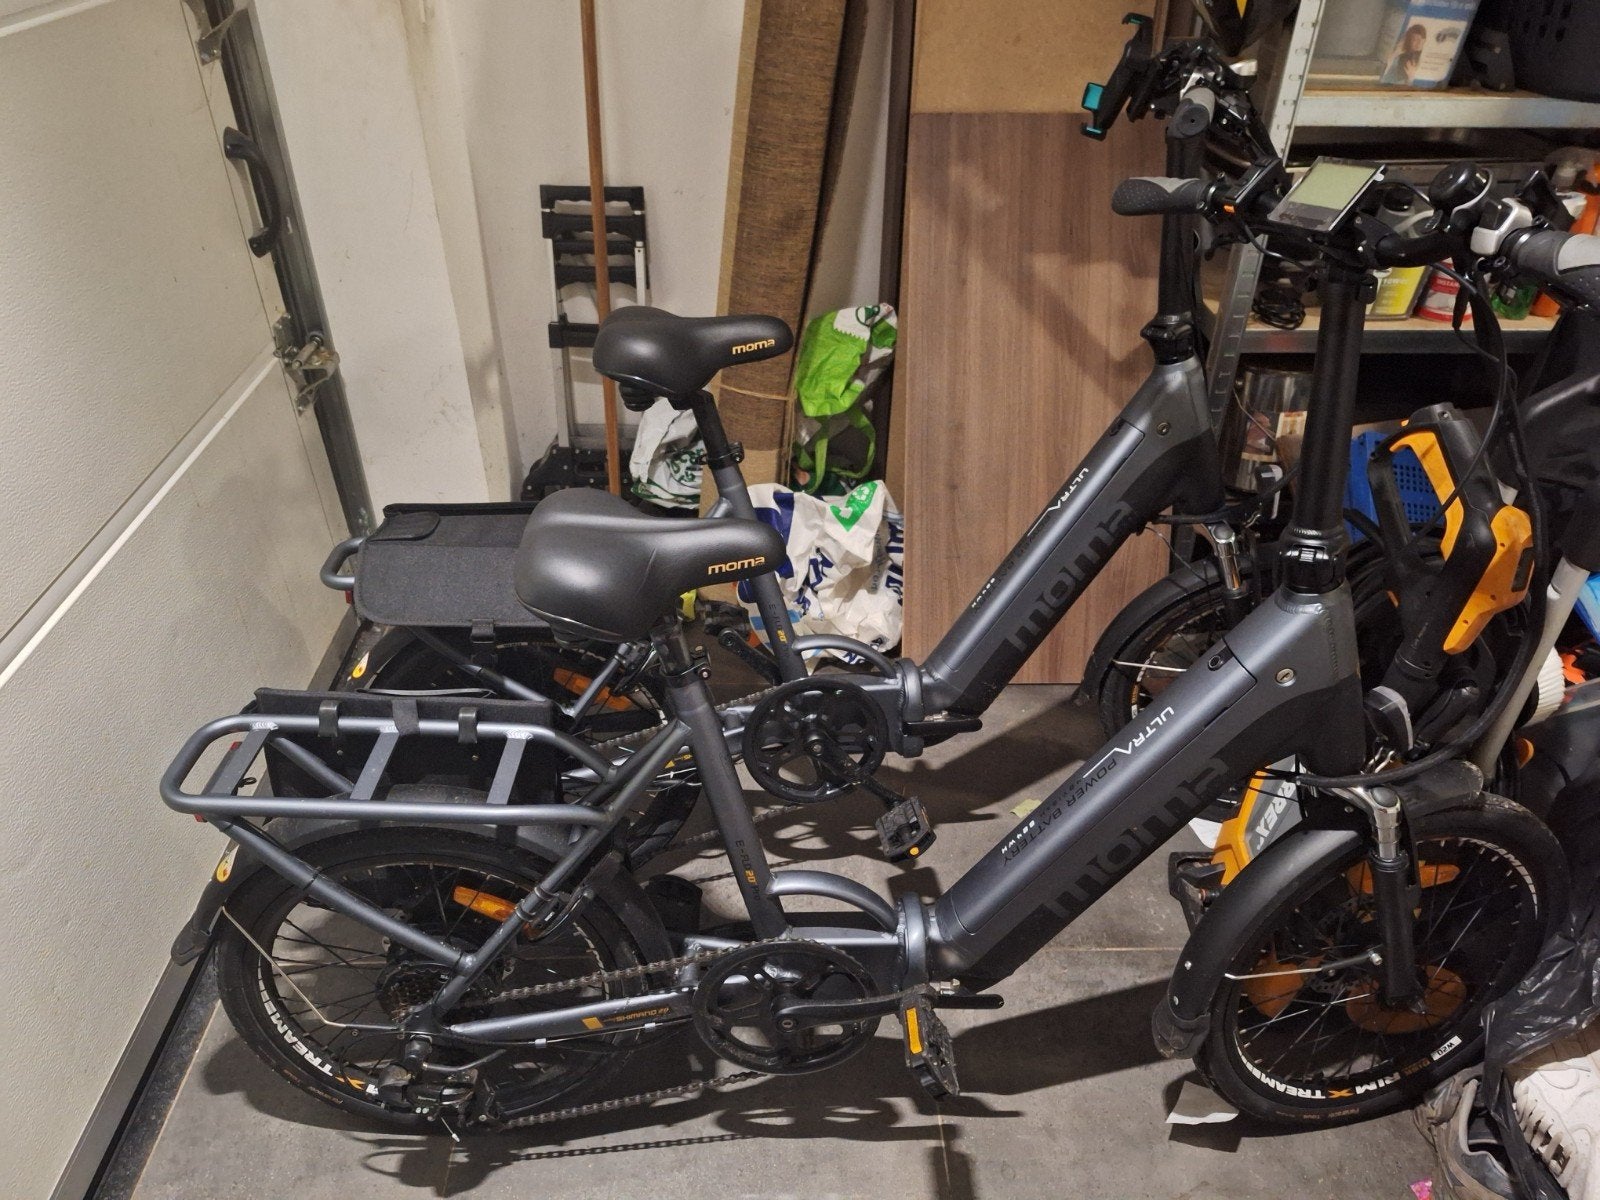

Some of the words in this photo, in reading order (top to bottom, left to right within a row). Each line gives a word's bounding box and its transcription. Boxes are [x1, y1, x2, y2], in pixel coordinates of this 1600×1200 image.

[732, 339, 776, 355] moma
[1048, 467, 1089, 511] ULTRA
[708, 556, 765, 575] moma
[1114, 705, 1175, 755] ULTRA
[1066, 758, 1117, 807] POWER
[1256, 765, 1303, 850] RREX
[1003, 809, 1062, 867] BATTERY
[1044, 758, 1229, 918] moma
[1355, 1071, 1401, 1095] RIM
